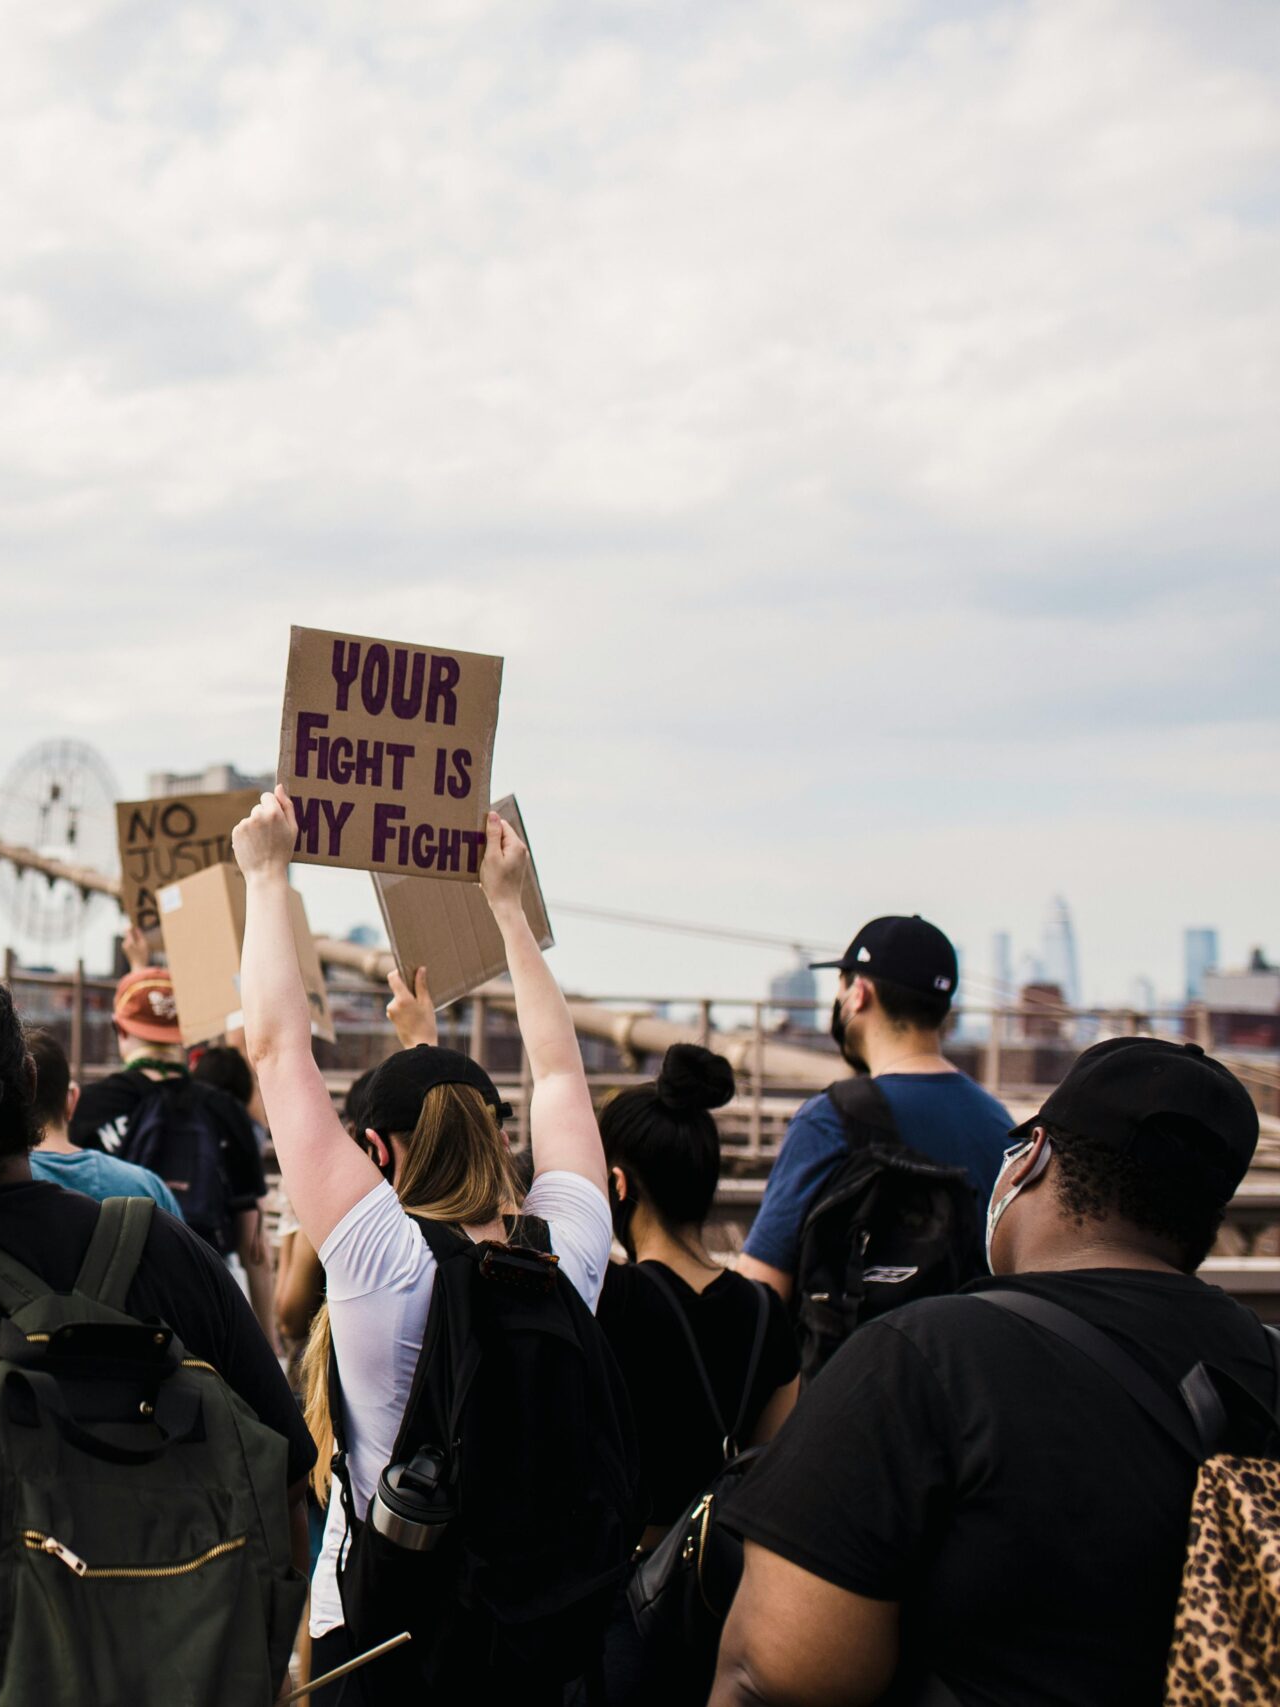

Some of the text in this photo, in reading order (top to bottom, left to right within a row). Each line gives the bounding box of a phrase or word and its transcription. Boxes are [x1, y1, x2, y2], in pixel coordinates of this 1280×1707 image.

[331, 639, 461, 726] YOUR
[294, 711, 473, 799] FIGHT IS
[126, 834, 234, 884] JUSTI
[127, 802, 197, 844] NO
[290, 796, 487, 874] MY FIGHT
